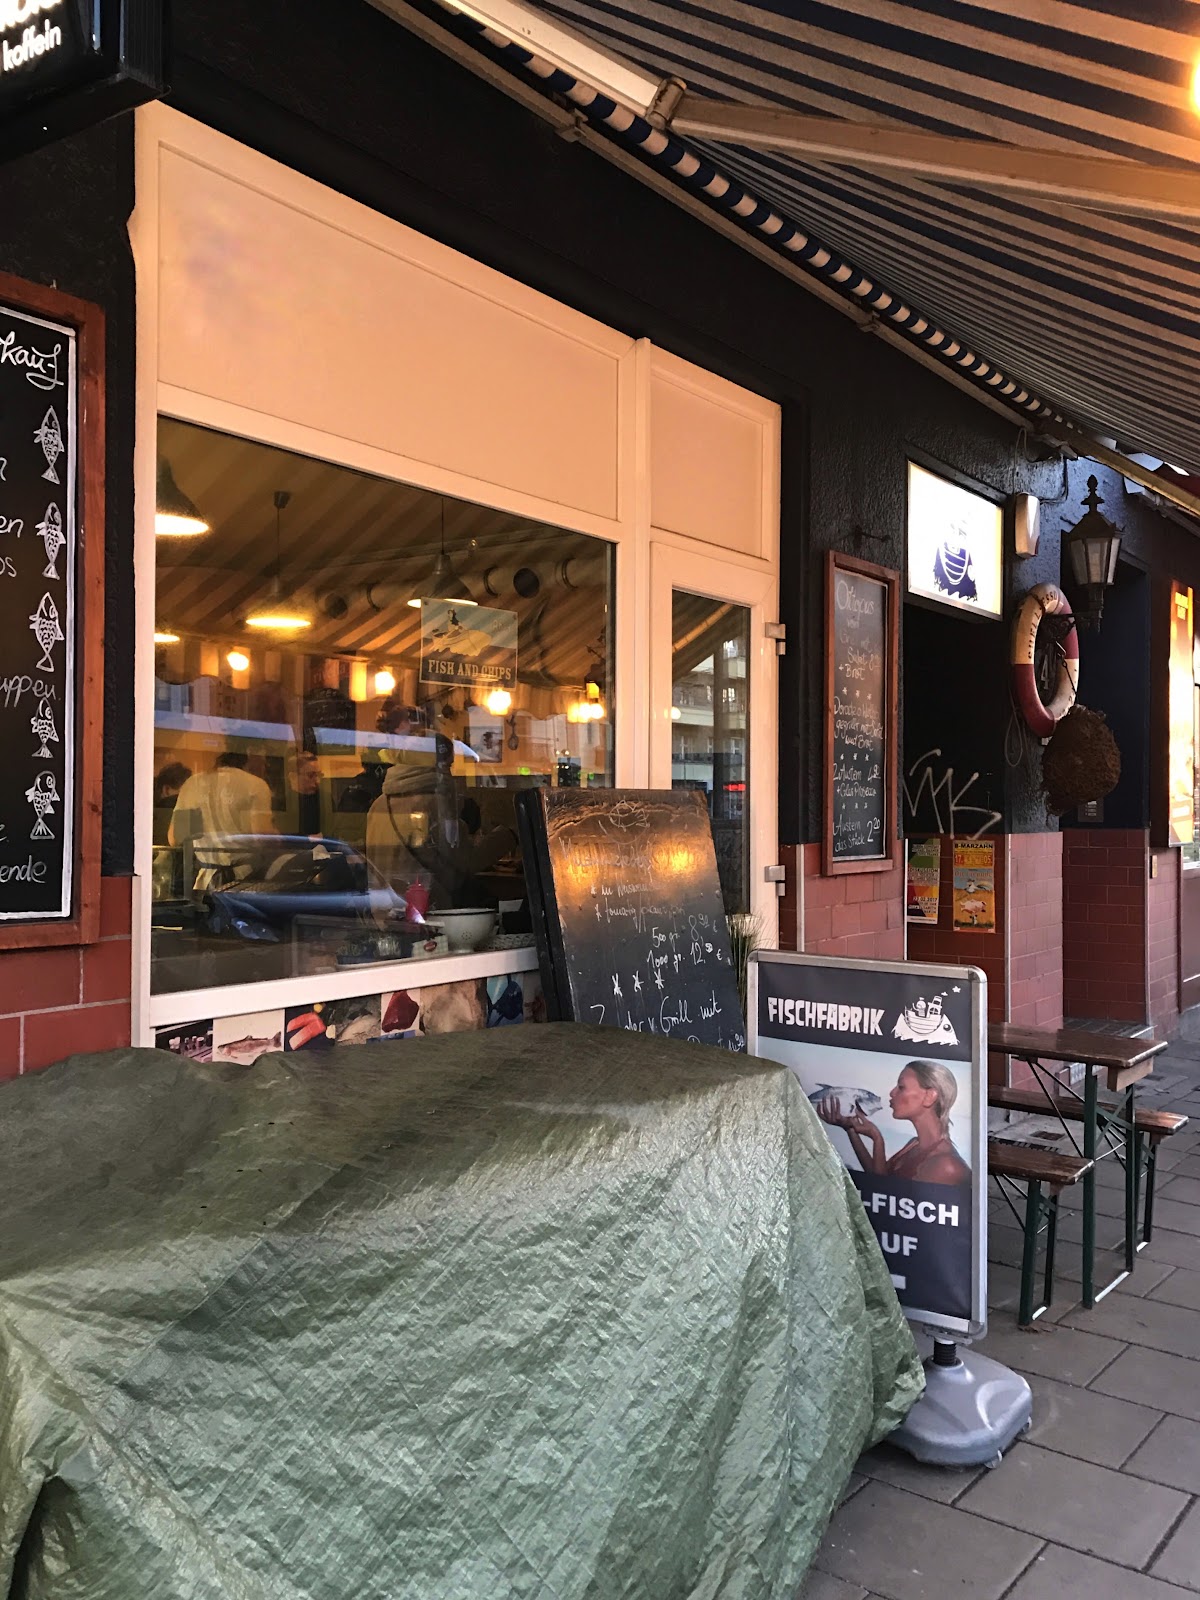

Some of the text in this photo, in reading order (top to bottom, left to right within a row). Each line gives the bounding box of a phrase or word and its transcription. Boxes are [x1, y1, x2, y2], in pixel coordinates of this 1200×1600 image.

[428, 659, 512, 680] FISH AND CHIPS
[660, 996, 693, 1038] Grill
[767, 996, 885, 1036] FISCHFABRIK
